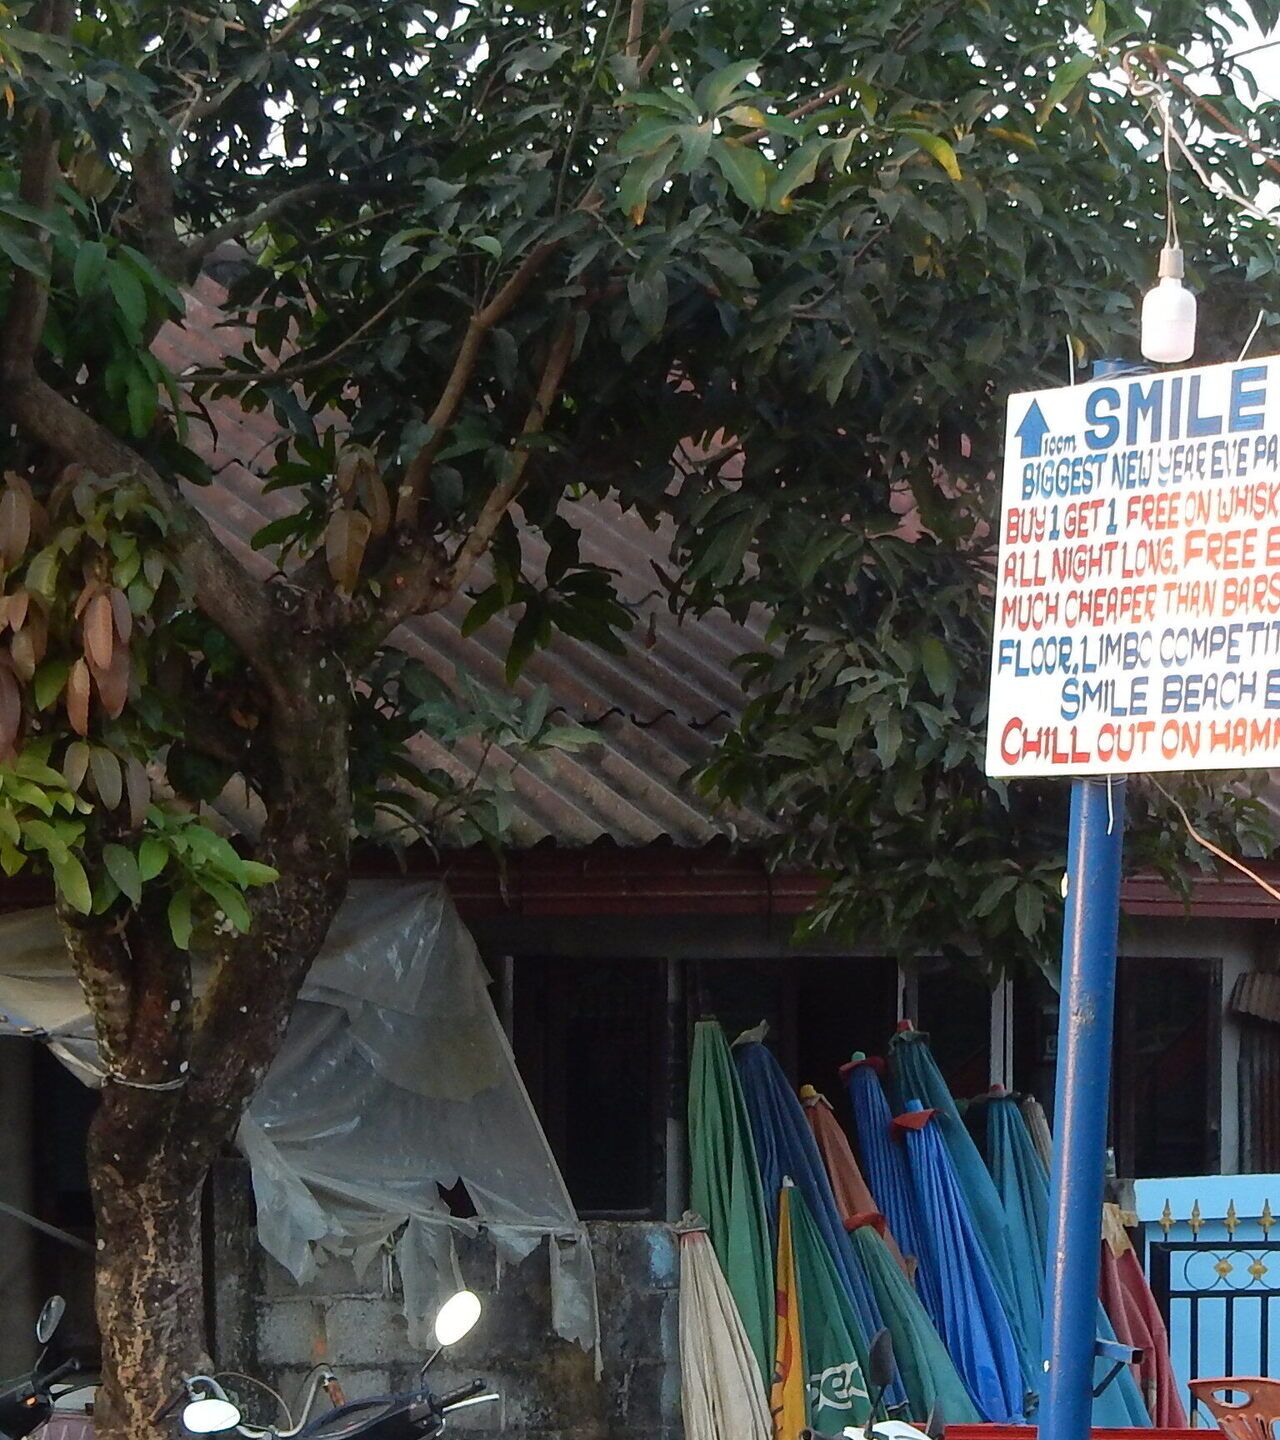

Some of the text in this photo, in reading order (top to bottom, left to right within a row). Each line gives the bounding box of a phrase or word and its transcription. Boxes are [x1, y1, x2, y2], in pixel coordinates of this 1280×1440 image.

[1084, 364, 1269, 451] SMILE
[1021, 453, 1108, 501] BIGGEST
[1112, 449, 1154, 491] NEW
[1158, 441, 1208, 488] YEAR
[1210, 435, 1250, 480] EVE
[1005, 505, 1047, 546] BUY
[1048, 504, 1060, 542] 1
[1063, 498, 1106, 539] GET
[1106, 497, 1118, 536] 1
[1126, 490, 1183, 531] FREE
[1183, 487, 1213, 529] ON
[1004, 551, 1047, 588] ALL
[1052, 539, 1119, 584] NIGHT
[1183, 527, 1258, 571] FREE
[1000, 591, 1060, 633] MUCH
[1064, 583, 1158, 629] CHEAPER
[1162, 579, 1217, 619] THAN
[1060, 675, 1150, 722] SMILE
[1160, 670, 1258, 714] BEACH
[1000, 716, 1091, 766] CHILL
[1097, 720, 1156, 763] OUT
[1160, 718, 1202, 760] ON
